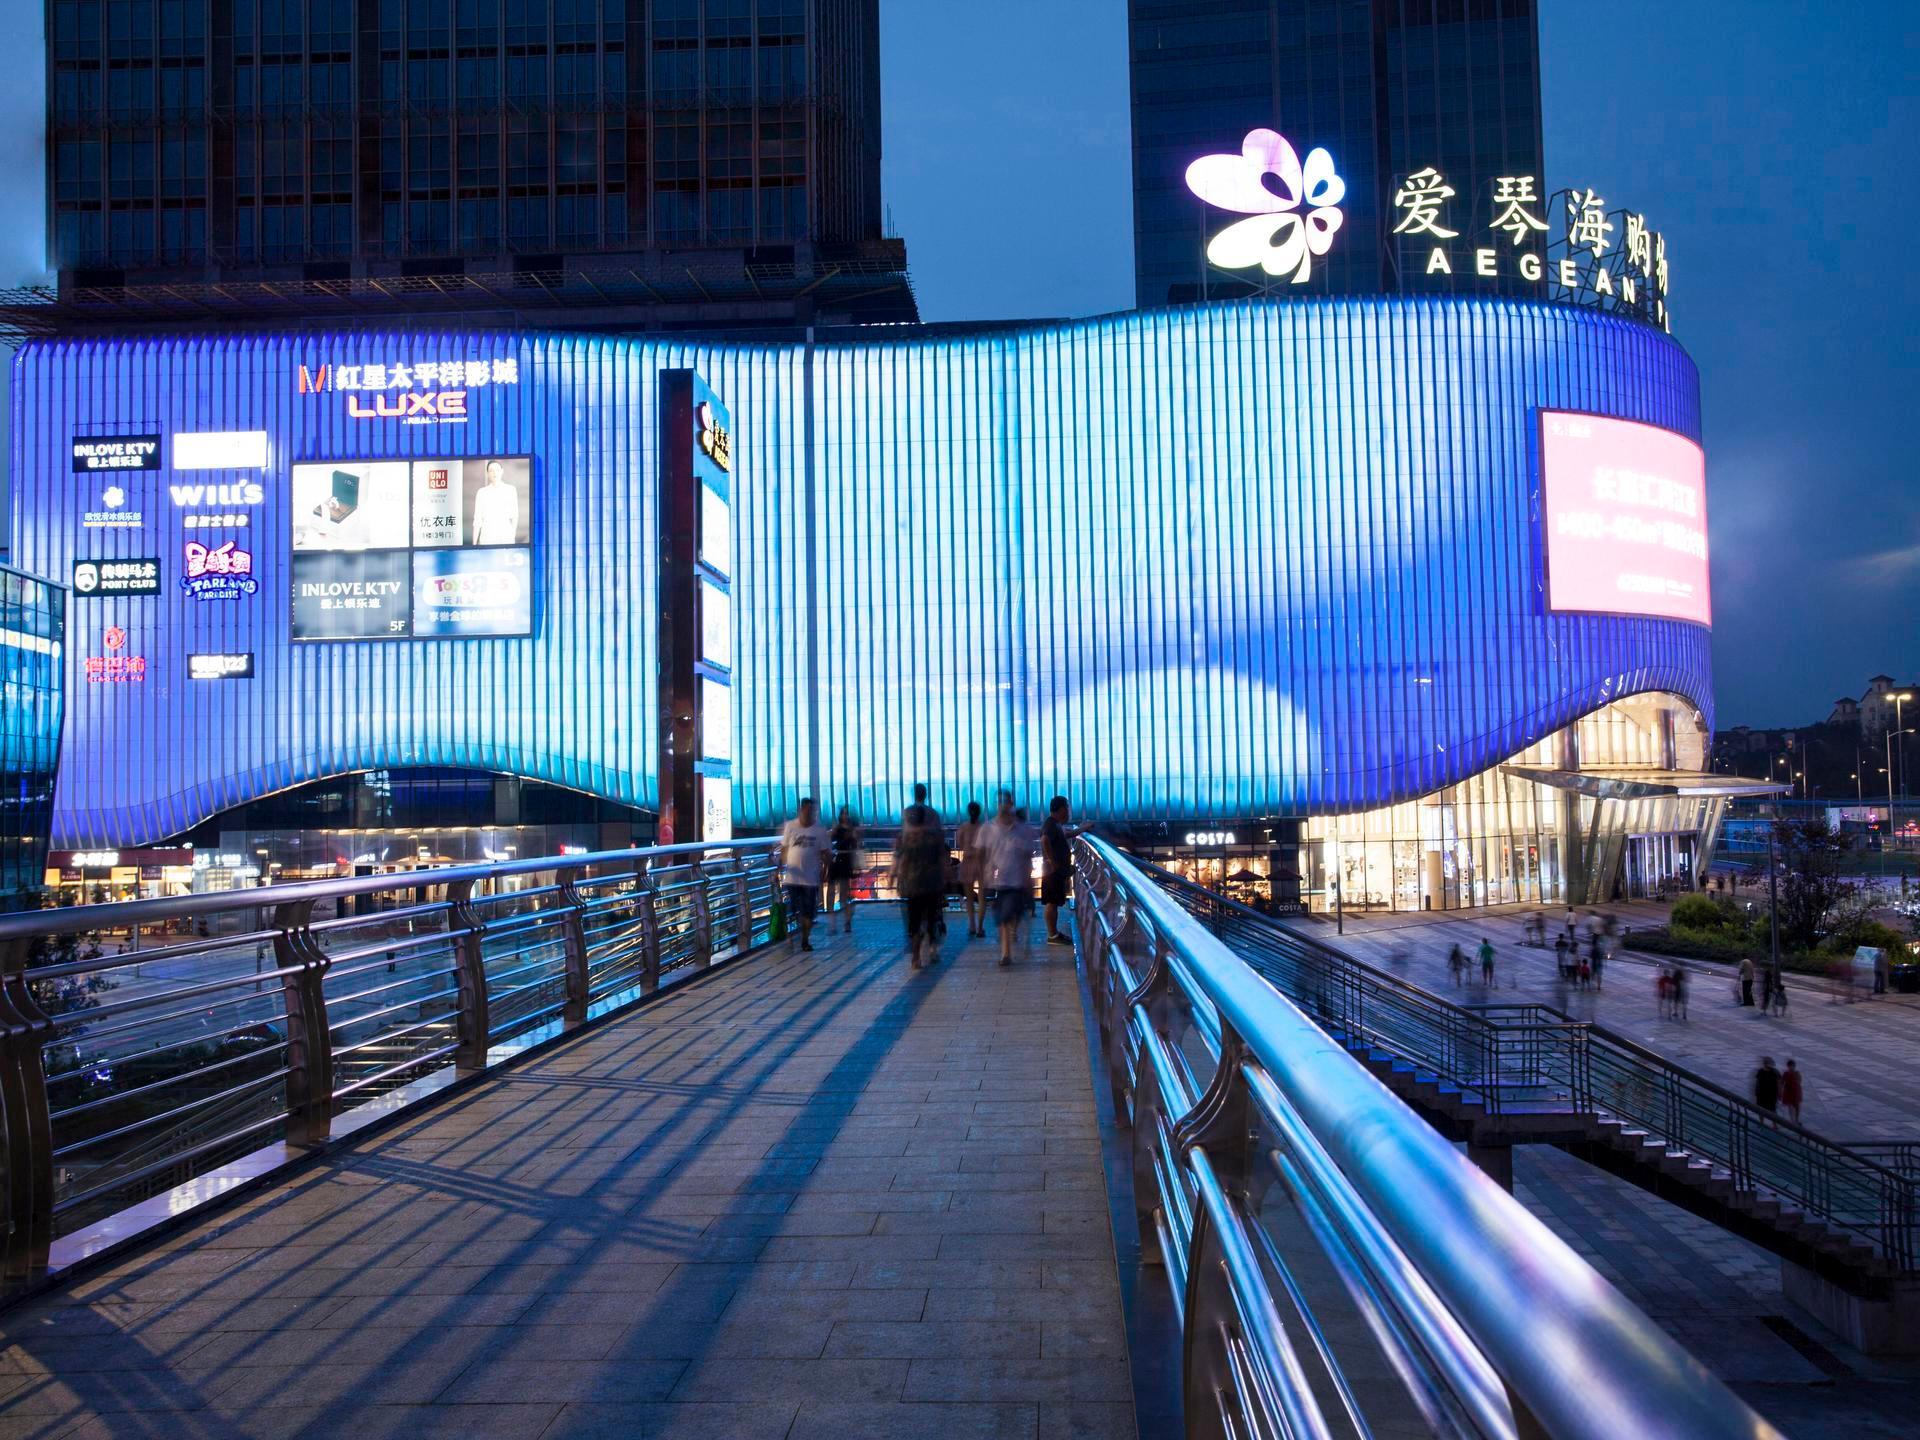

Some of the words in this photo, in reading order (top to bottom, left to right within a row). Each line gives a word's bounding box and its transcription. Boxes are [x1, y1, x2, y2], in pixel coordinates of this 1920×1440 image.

[1426, 247, 1636, 304] AEGEAN
[349, 391, 467, 418] LUXE
[74, 443, 124, 457] INLOVE
[125, 442, 156, 455] KTV
[430, 471, 445, 480] UNI
[430, 480, 446, 489] QLO
[420, 515, 457, 528] 优衣库
[129, 579, 157, 588] CLUB
[302, 582, 364, 597] INLOVE
[365, 581, 401, 595] KTV
[390, 620, 405, 631] 5F
[1185, 832, 1236, 845] COSTA
[1279, 904, 1303, 912] COSTA
